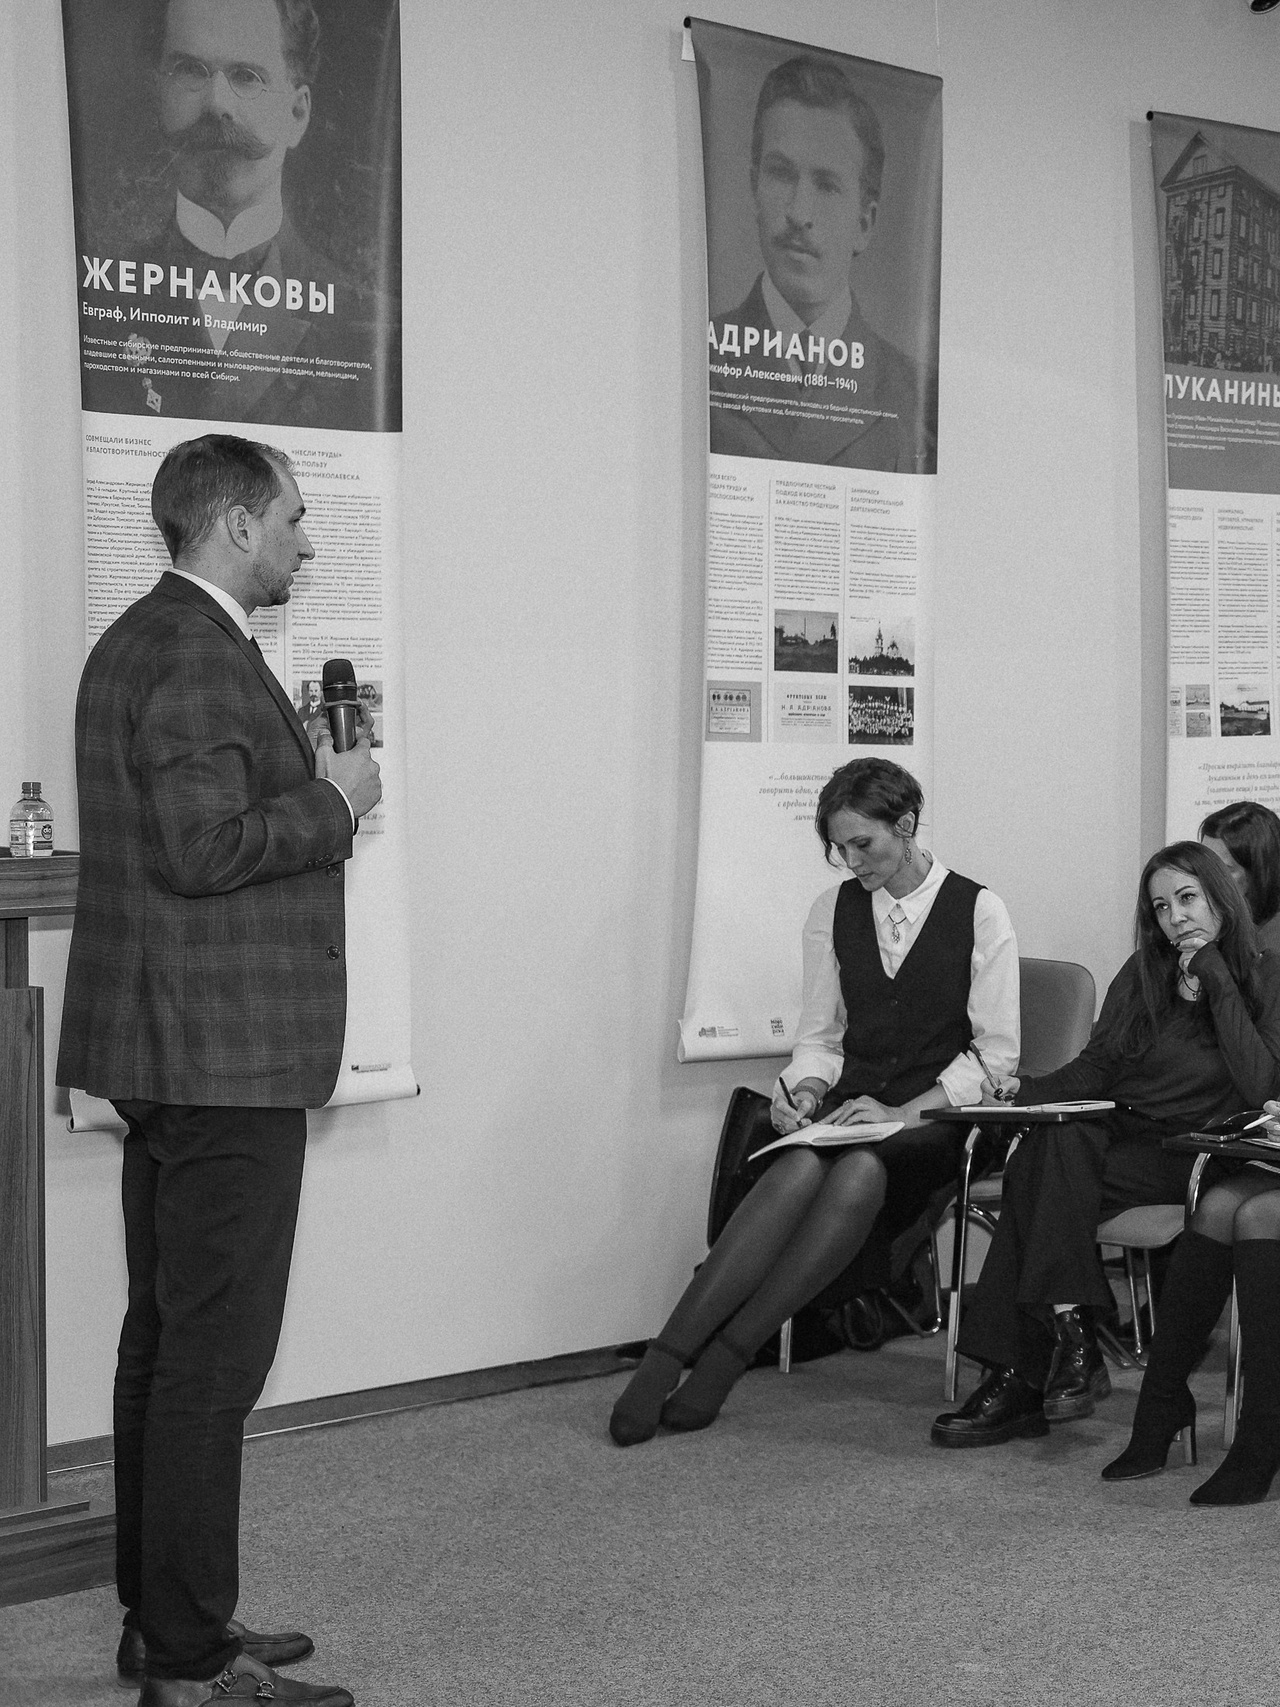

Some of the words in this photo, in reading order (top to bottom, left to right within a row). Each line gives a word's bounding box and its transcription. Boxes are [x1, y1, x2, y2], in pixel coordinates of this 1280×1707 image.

[82, 255, 335, 315] ЖЕРНАКОВЫ
[82, 302, 127, 323] Евграф,
[129, 307, 189, 327] Ипполит
[191, 316, 201, 327] и
[203, 315, 268, 336] Владимир
[229, 349, 281, 361] общественные
[281, 354, 309, 364] деятели
[315, 356, 373, 370] благотворители,
[708, 321, 865, 370] АДРИАНОВ
[136, 368, 180, 377] магазинами
[191, 371, 210, 379] всей
[210, 371, 241, 382] Сибири.
[157, 356, 216, 368] салотопенными
[223, 362, 281, 373] мыловаренными
[281, 368, 316, 378] заводами,
[315, 371, 359, 381] мельницами,
[709, 362, 743, 379] икифор
[743, 365, 803, 384] Алексеевич
[803, 373, 858, 394] (1881–1941)
[85, 434, 124, 445] СОВМЕЩАЛИ
[124, 437, 152, 446] БИЗНЕС
